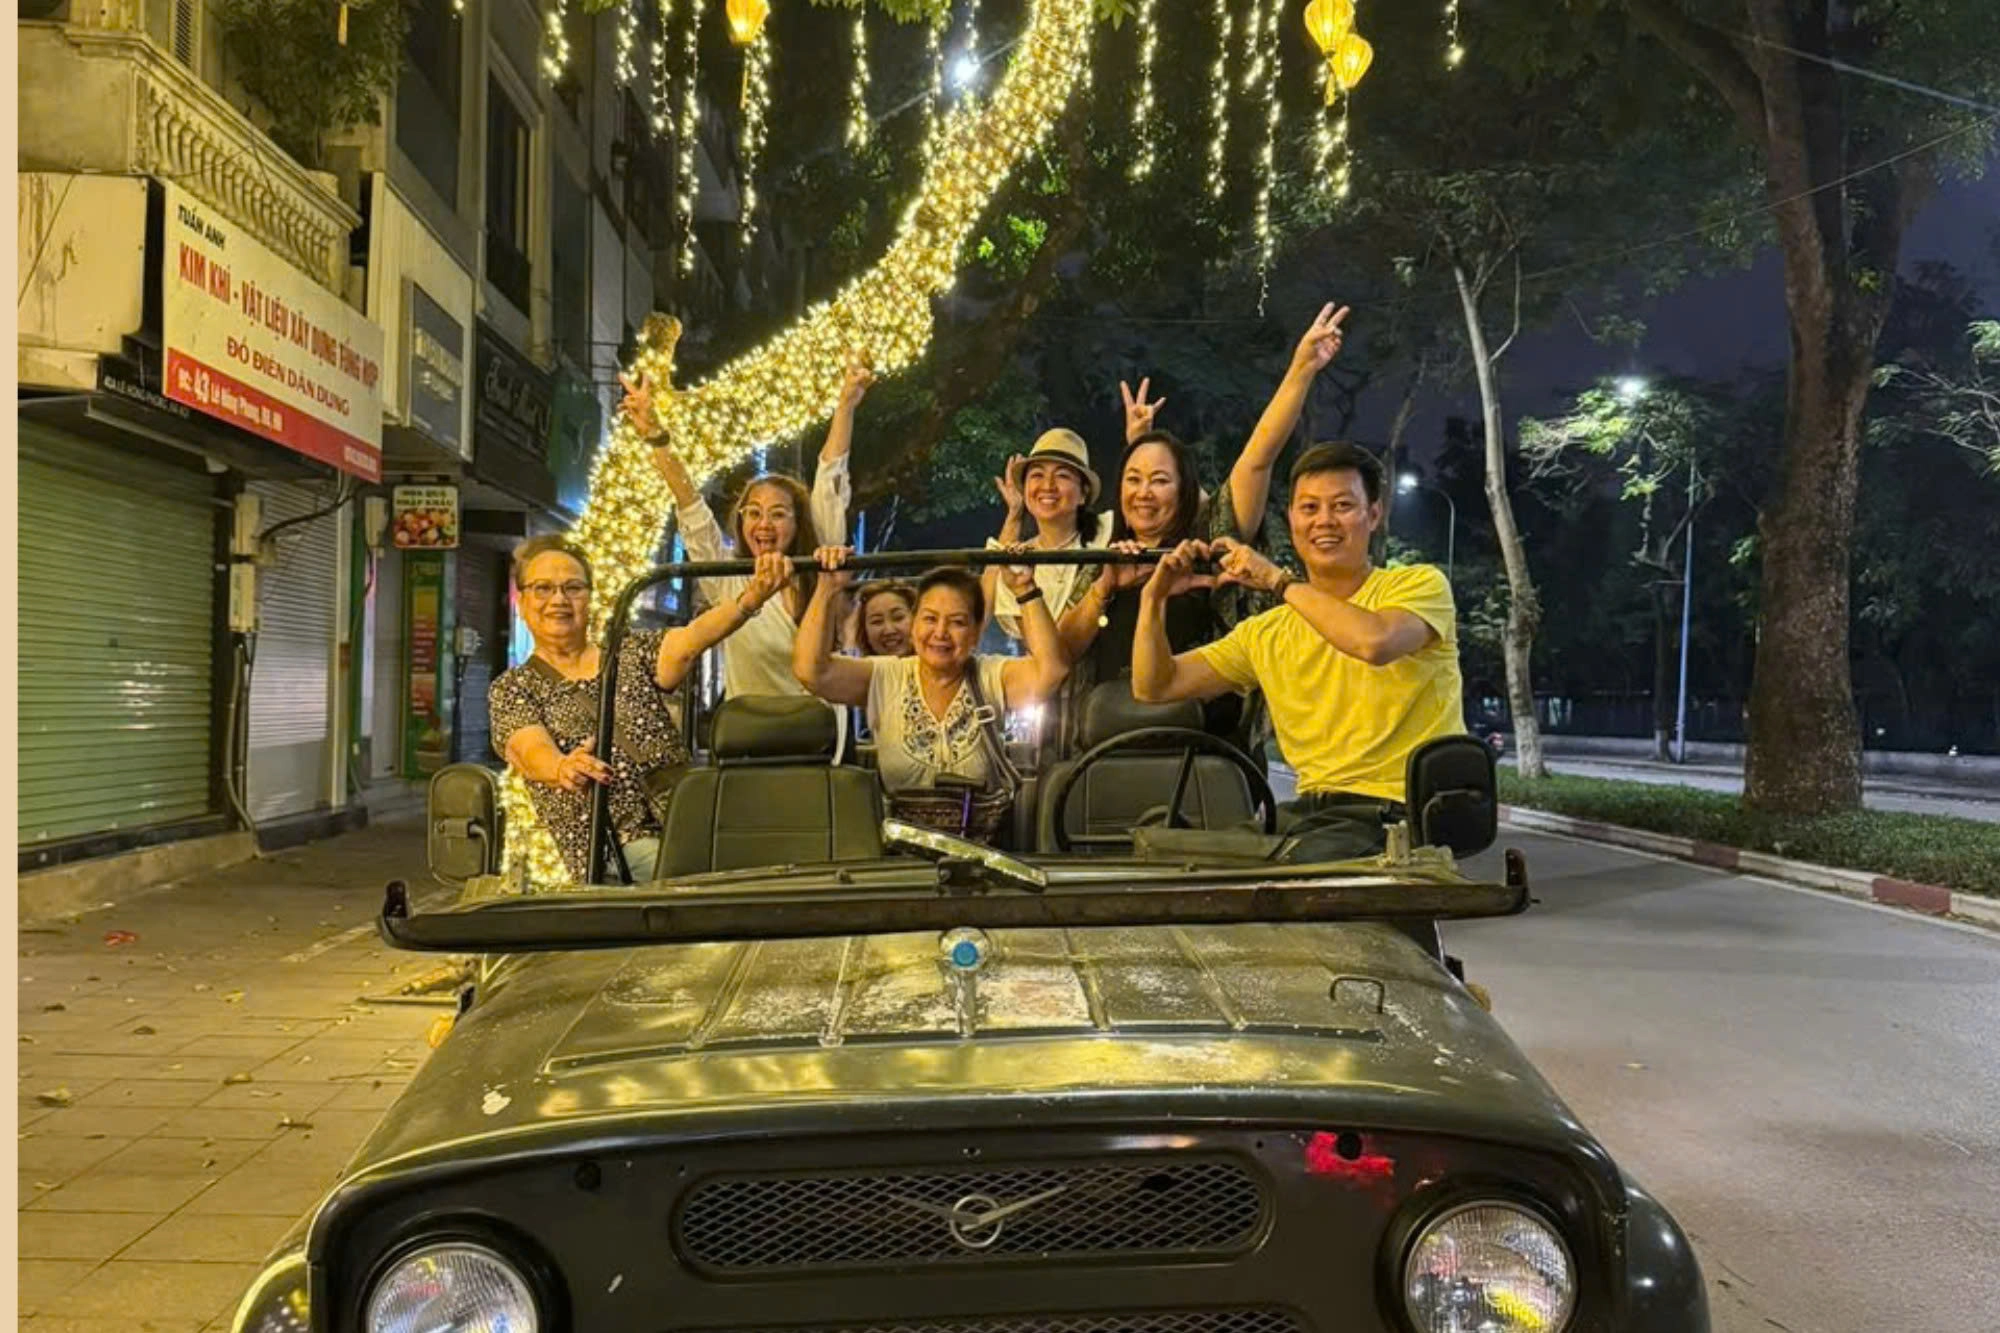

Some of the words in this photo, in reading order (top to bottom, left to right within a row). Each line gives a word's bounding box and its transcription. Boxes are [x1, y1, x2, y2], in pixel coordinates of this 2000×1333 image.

[205, 223, 225, 251] ANH
[180, 240, 206, 291] KIM
[209, 260, 230, 305] KHÍ
[242, 279, 262, 326] VẬT
[265, 295, 288, 340] LIỆU
